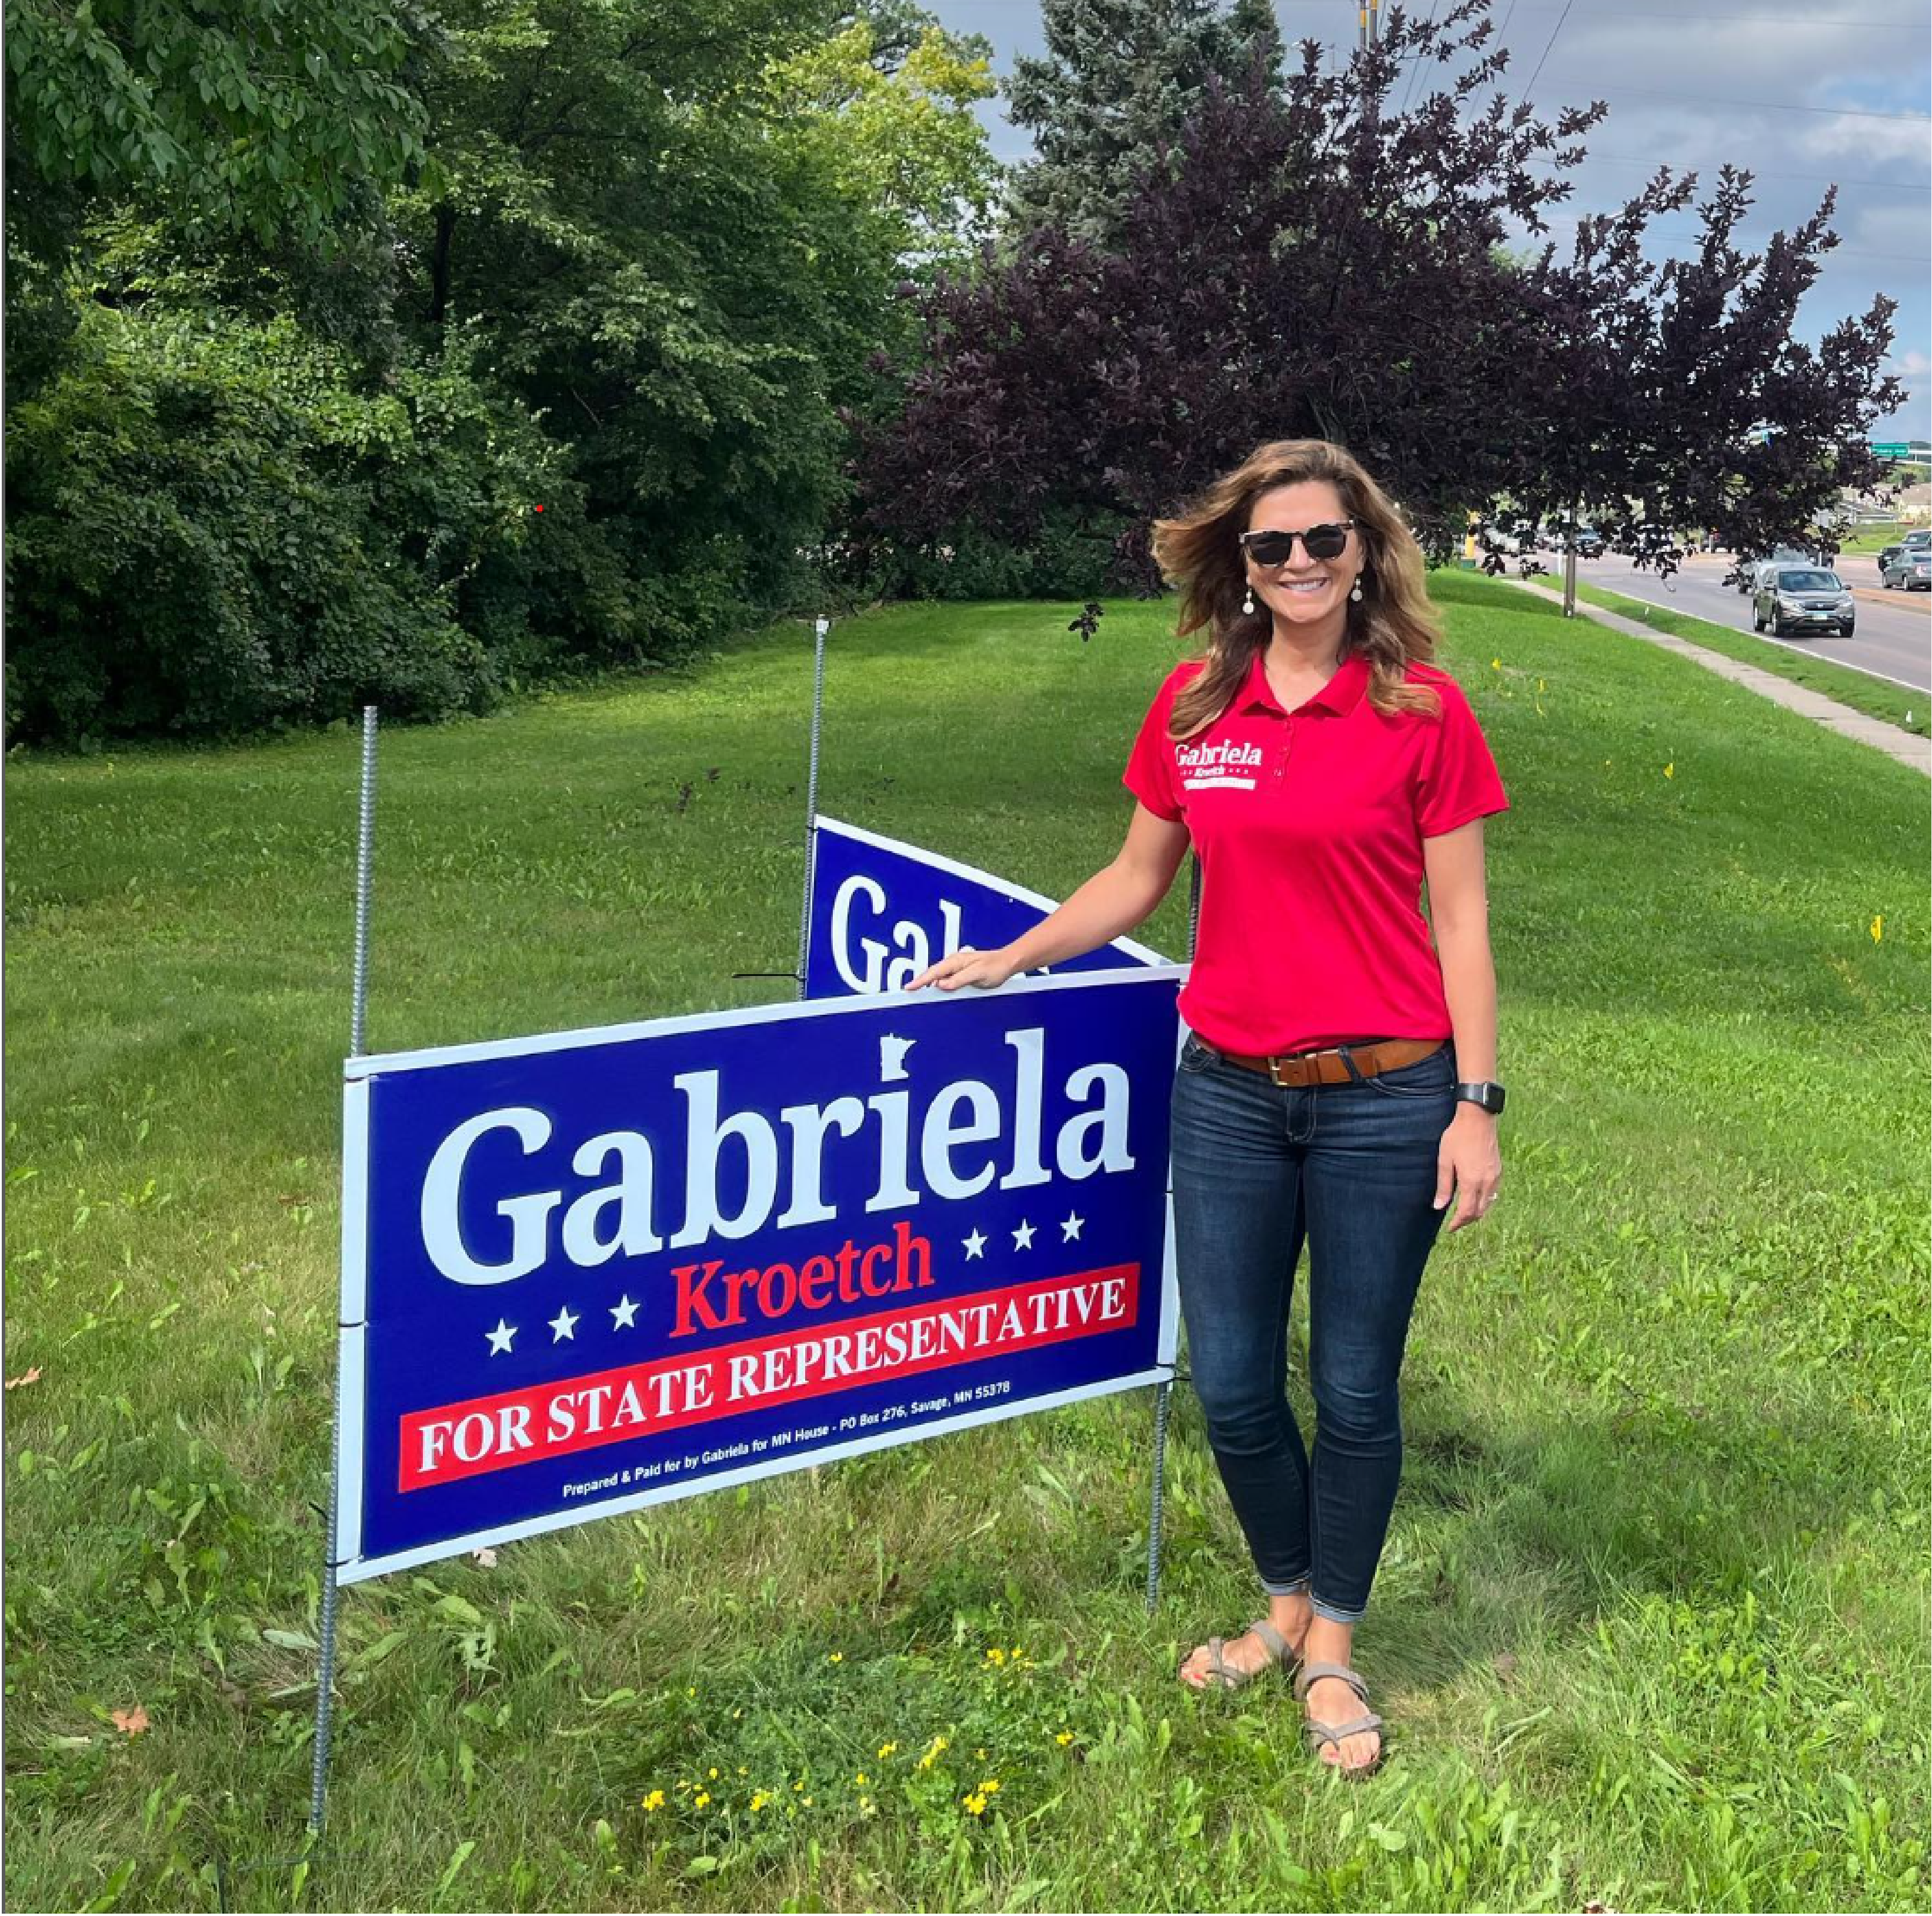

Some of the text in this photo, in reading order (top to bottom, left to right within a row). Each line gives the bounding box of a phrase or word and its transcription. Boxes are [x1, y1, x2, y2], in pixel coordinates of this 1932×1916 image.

[1175, 739, 1263, 766] Gabriela
[421, 1028, 1134, 1285] Gabriela
[669, 1221, 934, 1337] Kroetch
[419, 1279, 1125, 1472] FOR STATE REPRESENTATIVE
[563, 1471, 618, 1498] Prepared
[621, 1471, 631, 1483] &
[635, 1462, 660, 1481] Paid
[665, 1460, 680, 1473] for
[684, 1455, 699, 1470] by
[702, 1443, 749, 1464] Gabriela
[752, 1439, 769, 1452] for
[772, 1431, 791, 1447] MN
[795, 1426, 829, 1442] House
[840, 1417, 857, 1431] PO
[860, 1413, 879, 1427] Box
[882, 1406, 907, 1422] 276,
[954, 1389, 973, 1403] MN
[976, 1380, 1010, 1399] 55378
